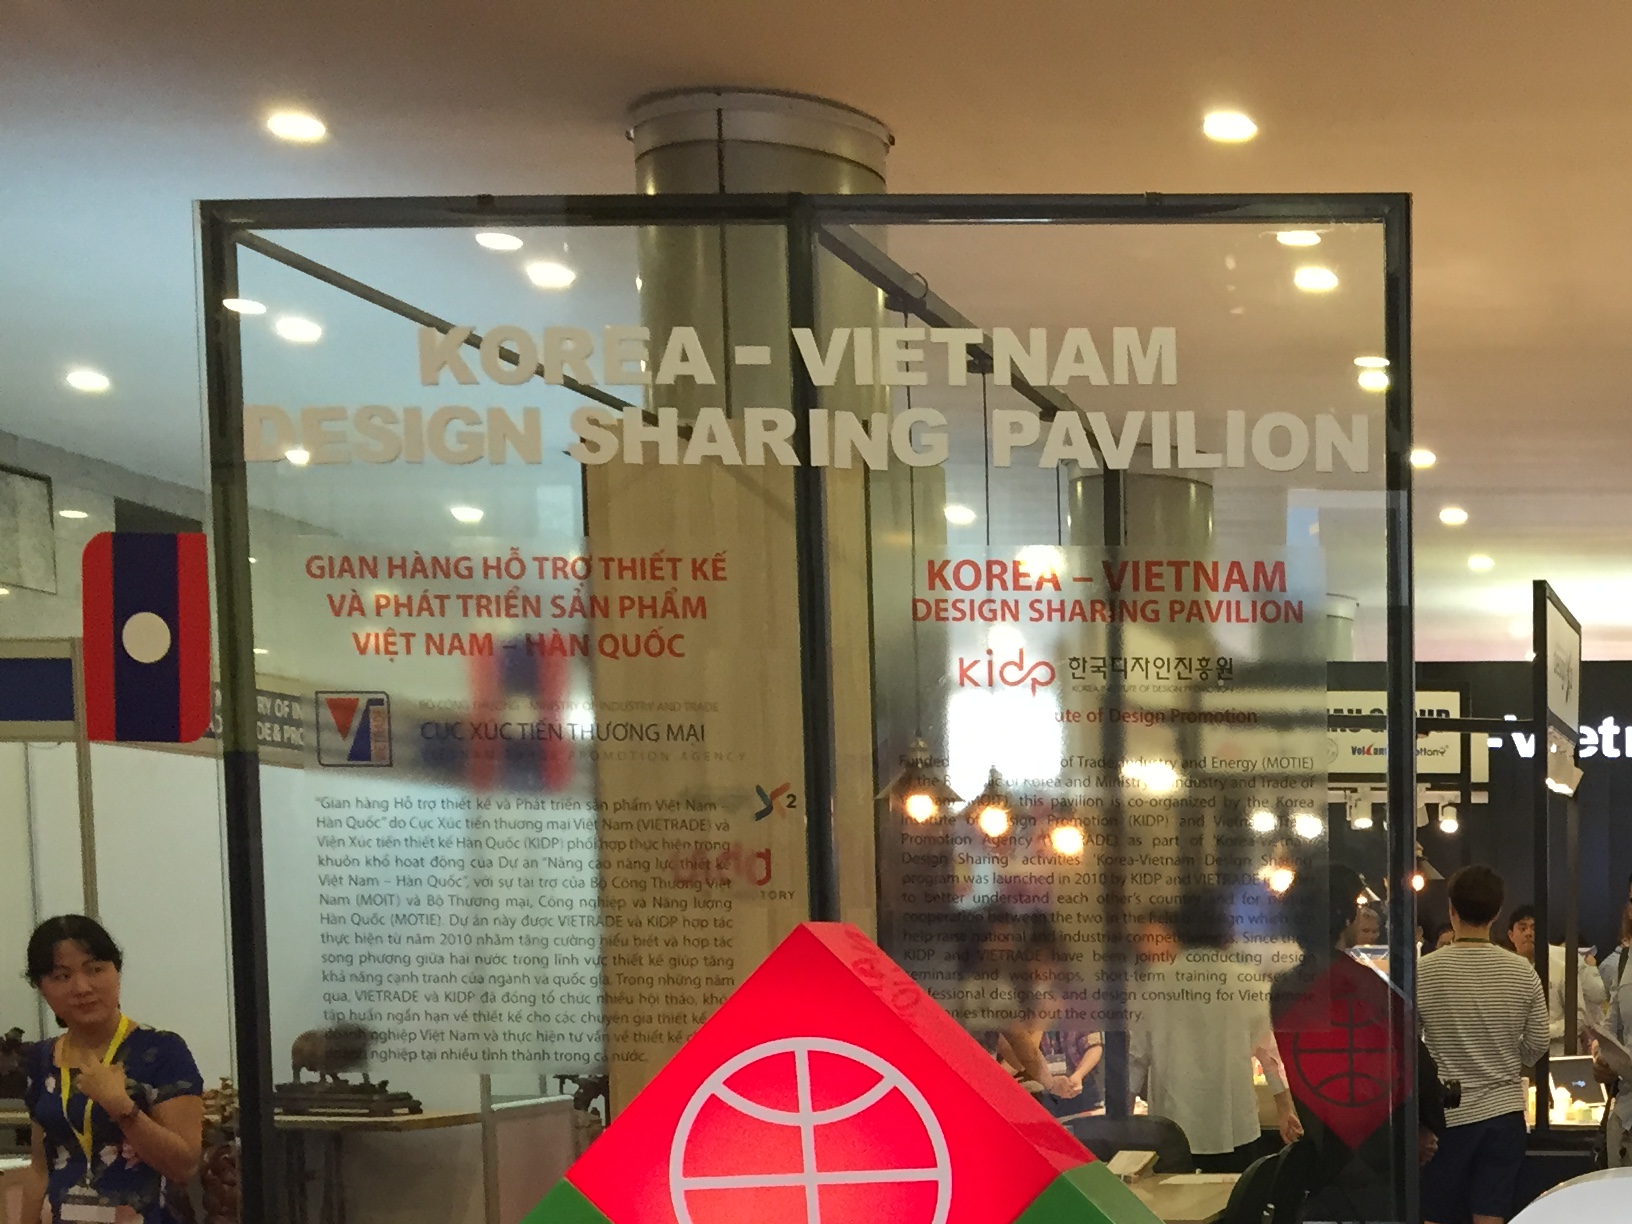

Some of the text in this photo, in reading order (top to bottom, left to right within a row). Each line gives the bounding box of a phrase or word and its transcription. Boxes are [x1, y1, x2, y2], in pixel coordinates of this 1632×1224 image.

[418, 326, 716, 386] KOREA
[792, 326, 1178, 387] VIETNAM
[243, 404, 1369, 474] DESIGN SHARING PAVILION
[305, 556, 382, 581] GIAN
[388, 550, 473, 581] HÀNG
[538, 554, 593, 589] TRỢ
[600, 549, 683, 583] THIẾT
[691, 549, 728, 583] KẾ
[926, 558, 1061, 593] KOREA
[1107, 559, 1288, 594] VIETNAM
[327, 585, 708, 621] VÀ PHÁT TRIỂN SẢN PHẨM
[911, 597, 1304, 626] DESIGN SHARING PAVILION
[352, 630, 418, 664] VIỆT
[425, 631, 494, 658] NAM
[524, 627, 590, 658] HÀN
[597, 627, 686, 663] QUỐC
[1109, 708, 1164, 727] Design
[1171, 708, 1258, 724] Promotion
[470, 718, 512, 741] XÚC
[567, 720, 660, 743] THƯƠNG
[666, 722, 706, 747] MẠI
[1211, 757, 1257, 772] Energy
[1262, 757, 1314, 770] (MOTIE)
[1065, 776, 1090, 788] and
[1260, 776, 1299, 788] Trade
[686, 799, 716, 811] Nam
[1019, 795, 1043, 807] this
[1051, 795, 1103, 809] pavilion
[1128, 795, 1216, 810] co-organized
[389, 817, 406, 828] do
[1129, 815, 1169, 828] (KIDP)
[901, 833, 972, 845] Promotion
[1128, 836, 1142, 847] as
[1152, 836, 1179, 848] part
[901, 853, 948, 868] Design
[958, 852, 1009, 868] Sharing
[1022, 853, 1081, 866] activities
[348, 876, 380, 887] Nam
[964, 874, 989, 884] was
[993, 873, 1054, 884] launched
[1059, 873, 1070, 884] in
[1075, 873, 1106, 885] 2010
[1131, 874, 1162, 885] KIDP
[319, 894, 350, 906] Nam
[973, 892, 1048, 904] understand
[1057, 892, 1088, 904] each
[1051, 912, 1073, 923] the
[1077, 913, 1102, 923] two
[439, 933, 472, 945] 2010
[321, 953, 353, 966] song
[450, 952, 469, 964] hai
[513, 954, 549, 967] trong
[1052, 950, 1083, 961] have
[1135, 951, 1177, 965] jointly
[1186, 951, 1262, 965] conducting
[422, 972, 457, 984] tranh
[616, 973, 654, 988] Trong
[1176, 971, 1227, 984] training
[354, 990, 419, 1003] VIETRADE
[444, 990, 475, 1003] KIDP
[1062, 988, 1087, 1000] and
[1142, 989, 1211, 1004] consulting
[1216, 989, 1234, 1000] for
[527, 1011, 551, 1024] cho
[981, 1008, 1035, 1022] through
[1039, 1008, 1061, 1019] out
[1065, 1008, 1088, 1019] the
[450, 1030, 480, 1042] Nam
[554, 1051, 590, 1064] trong
